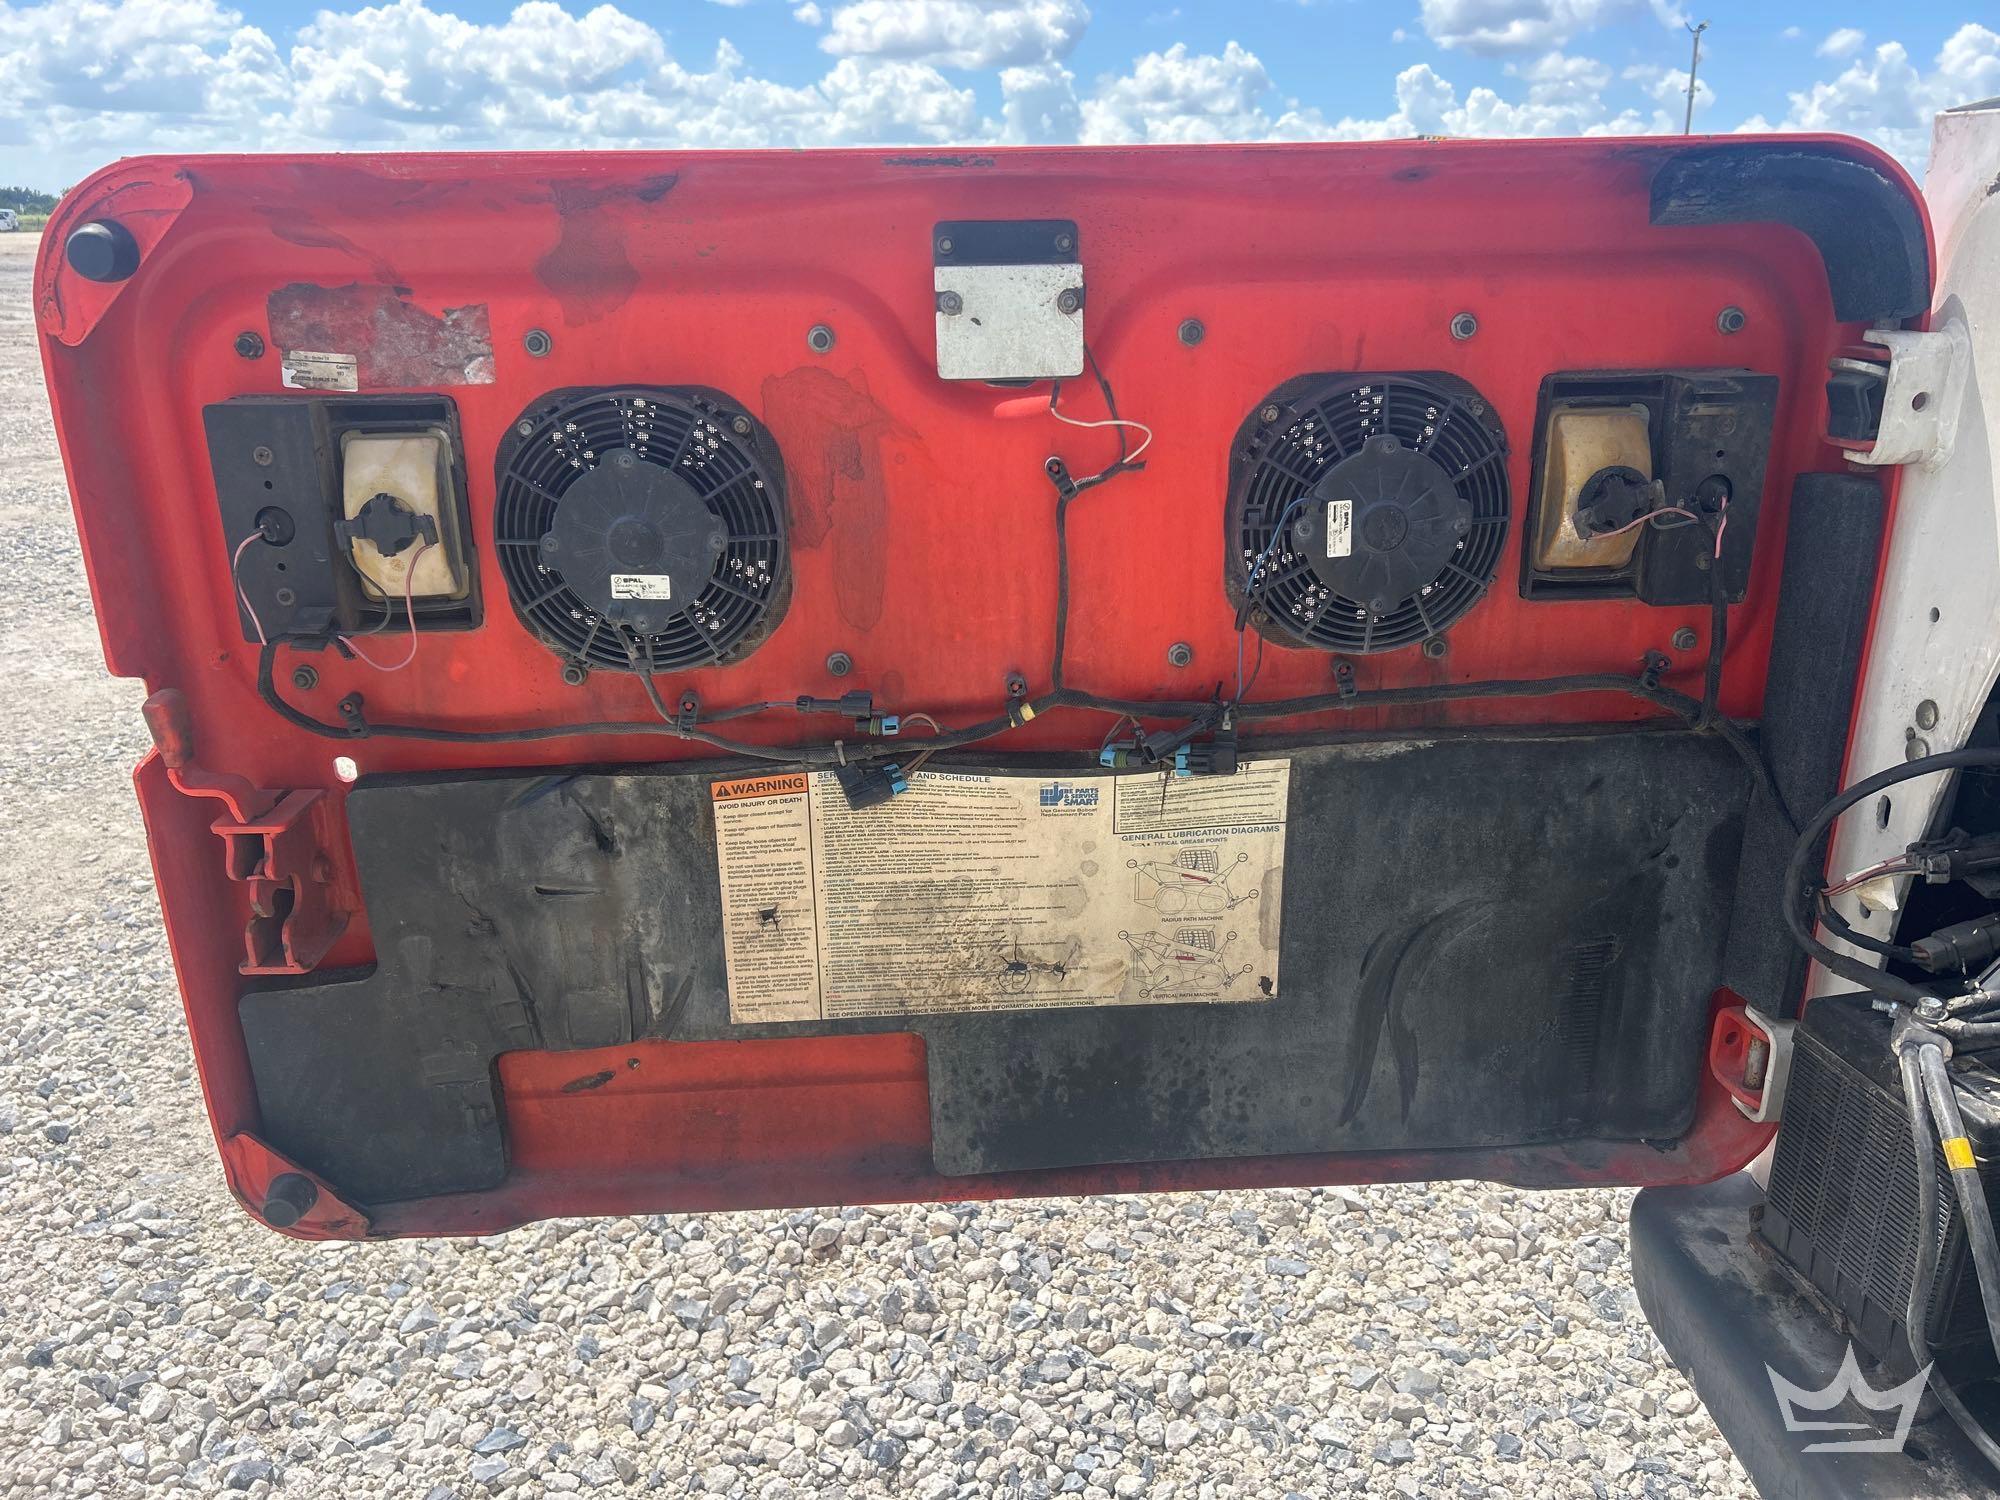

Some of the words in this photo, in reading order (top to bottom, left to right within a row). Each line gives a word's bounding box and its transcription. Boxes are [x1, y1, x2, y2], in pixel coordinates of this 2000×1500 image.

[731, 778, 804, 795] WARNING
[939, 773, 991, 783] SCHEDULE
[1121, 833, 1165, 842] GENERAL
[1168, 828, 1229, 839] LUBRICATION
[1231, 825, 1280, 834] DIAGRAMS
